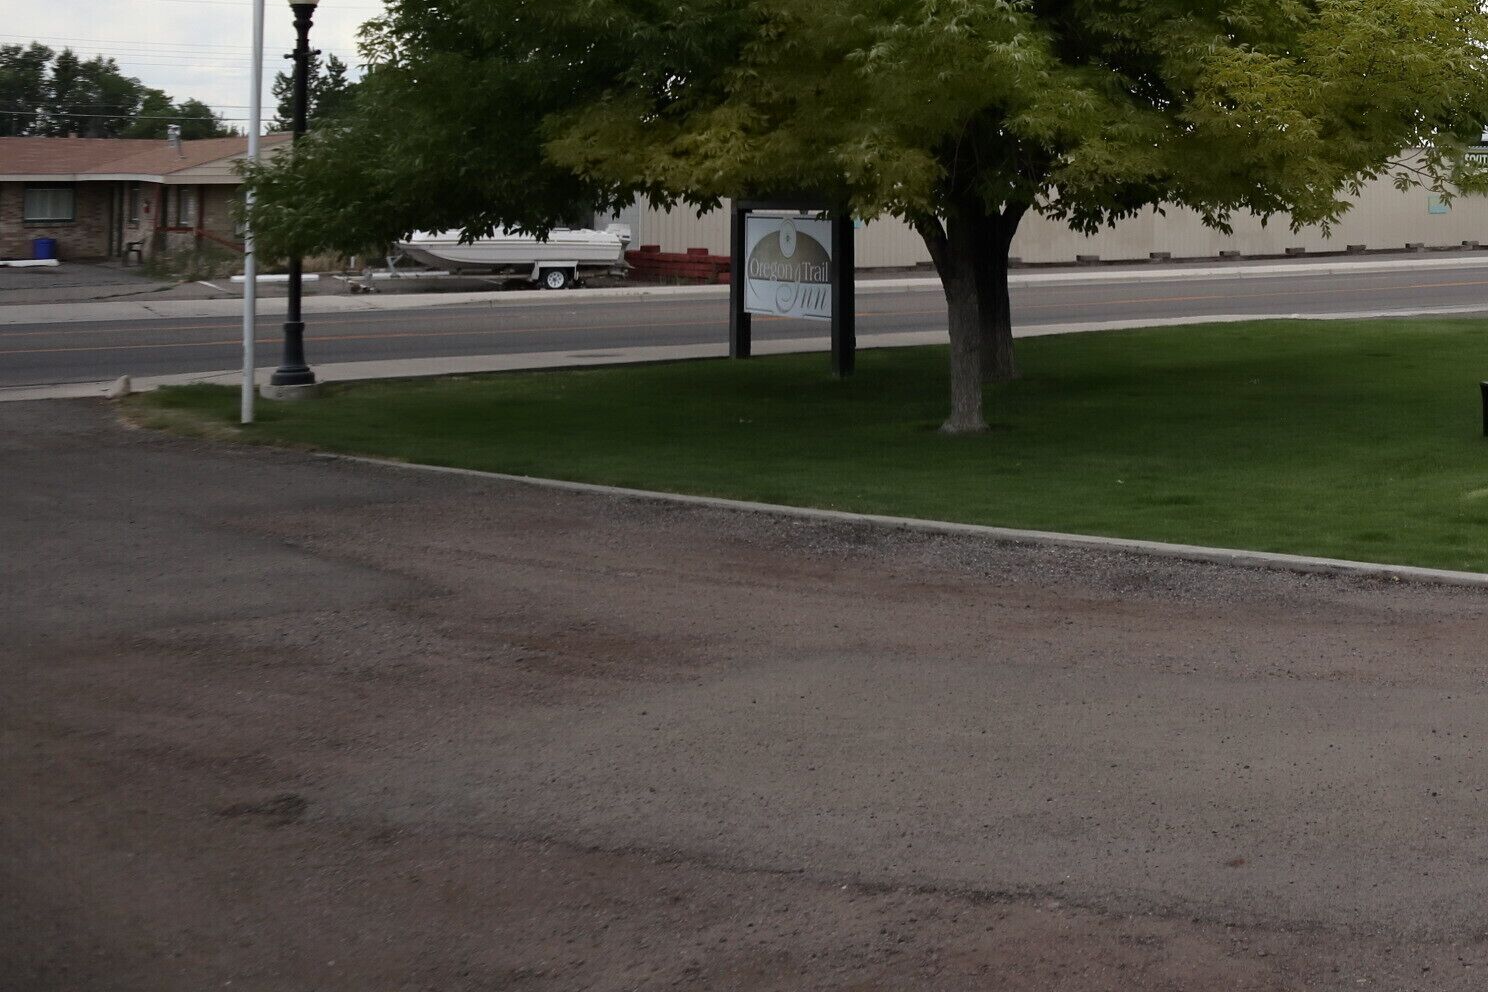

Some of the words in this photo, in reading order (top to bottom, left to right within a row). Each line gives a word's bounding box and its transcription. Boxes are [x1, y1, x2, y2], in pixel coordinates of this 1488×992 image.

[750, 259, 793, 282] Oregon
[801, 261, 829, 282] Trail
[775, 264, 829, 313] Inn
